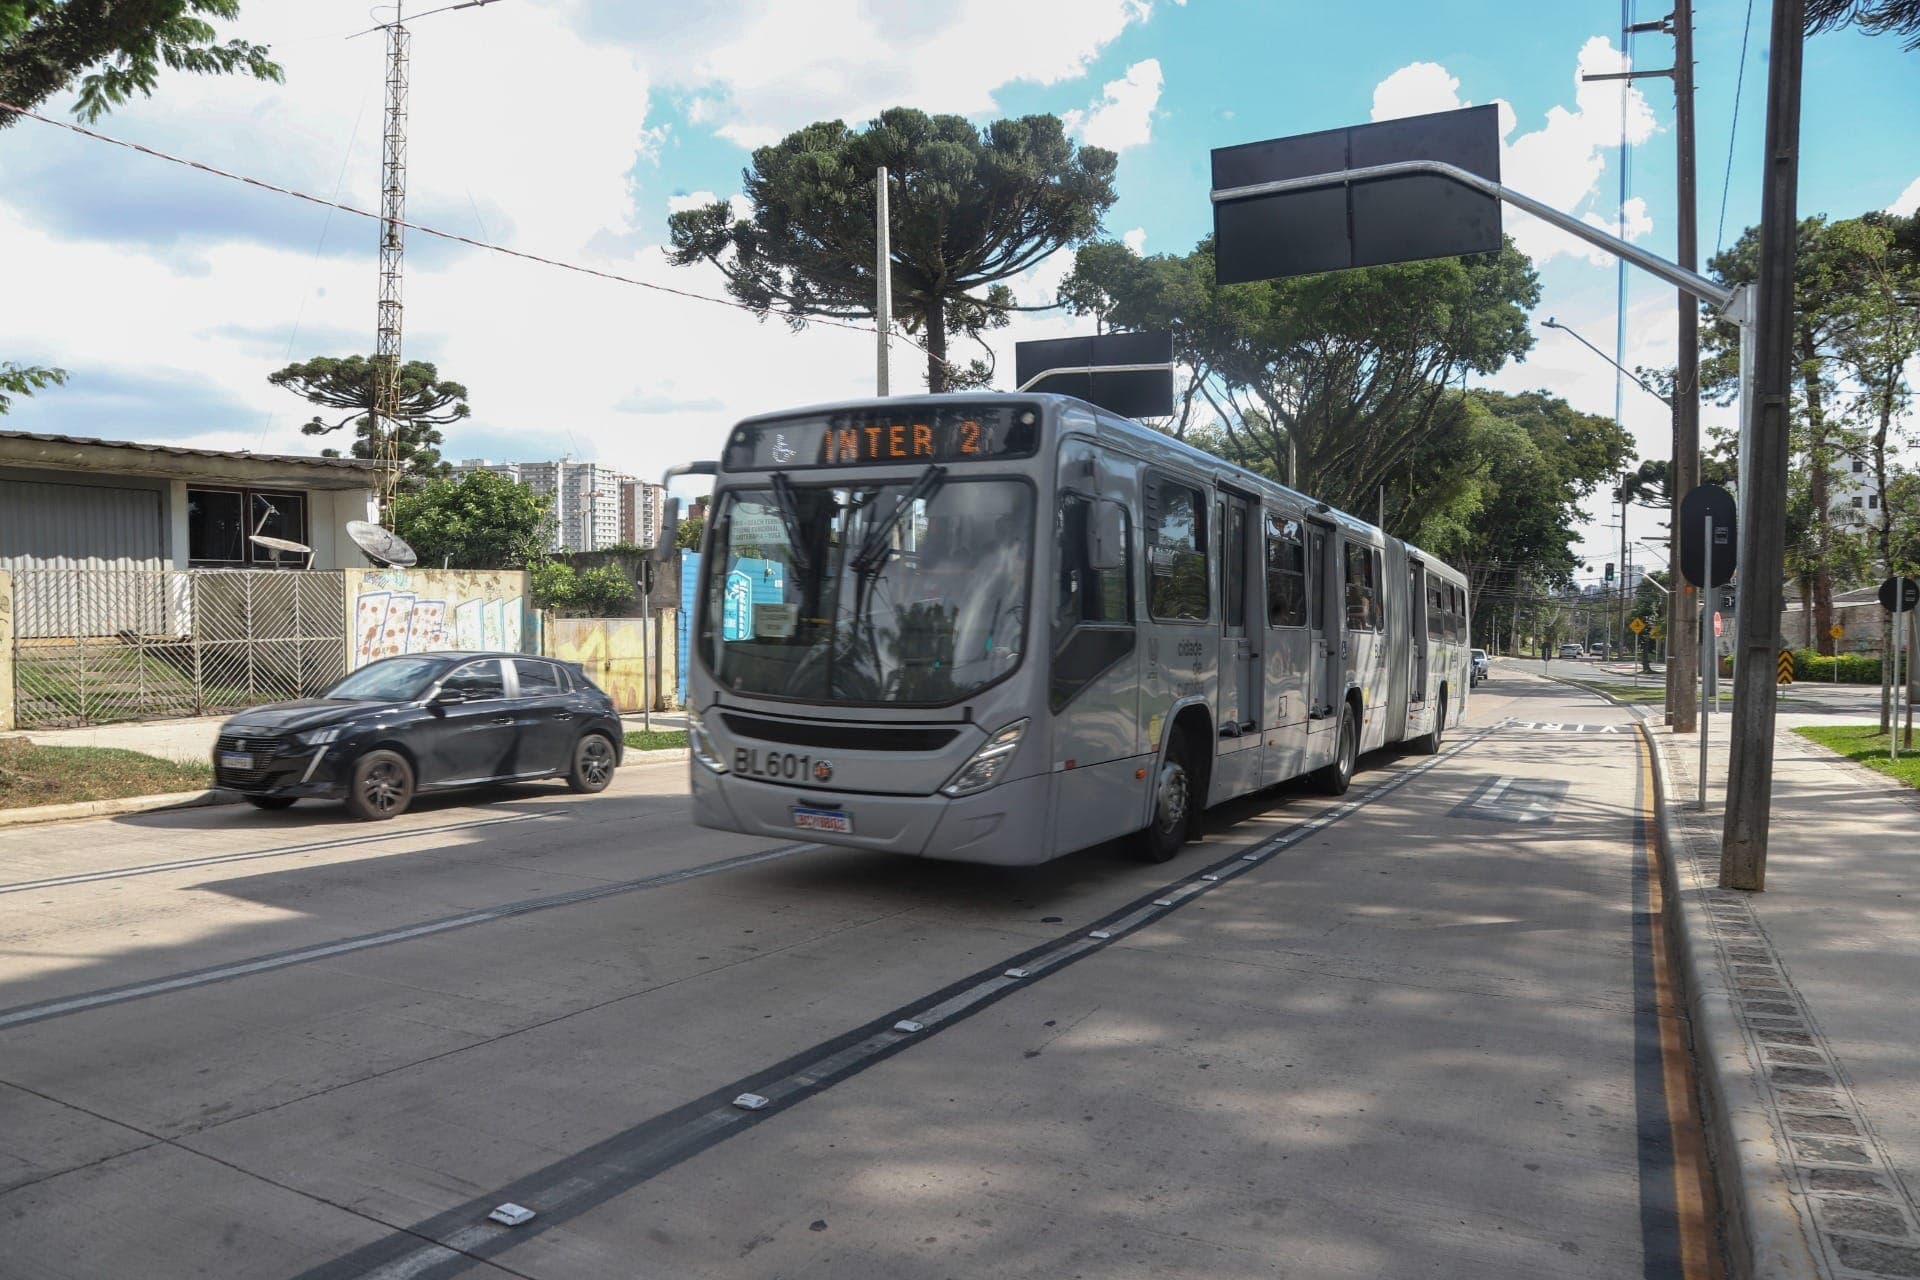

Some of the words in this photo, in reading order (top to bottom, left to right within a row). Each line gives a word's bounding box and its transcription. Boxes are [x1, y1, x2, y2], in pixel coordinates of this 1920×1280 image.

[824, 423, 934, 466] INTER
[960, 420, 981, 454] 2
[735, 747, 811, 781] BL601
